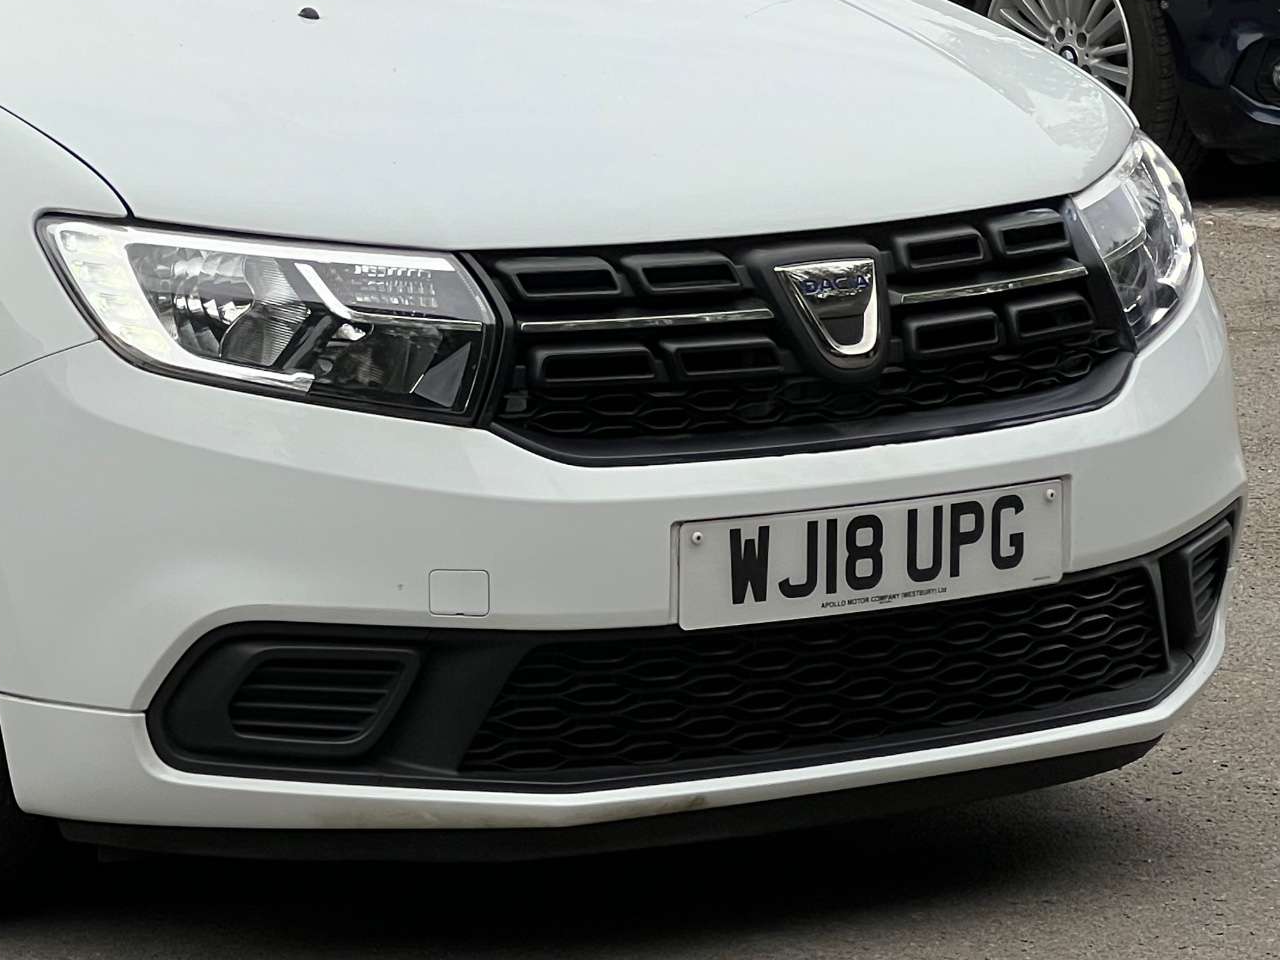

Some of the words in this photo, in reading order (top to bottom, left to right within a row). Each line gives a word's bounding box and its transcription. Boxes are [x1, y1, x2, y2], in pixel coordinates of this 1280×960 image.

[729, 514, 884, 605] WJ18
[907, 494, 1025, 583] UPG
[821, 599, 846, 609] APOLLO
[847, 597, 869, 605] MOTOR
